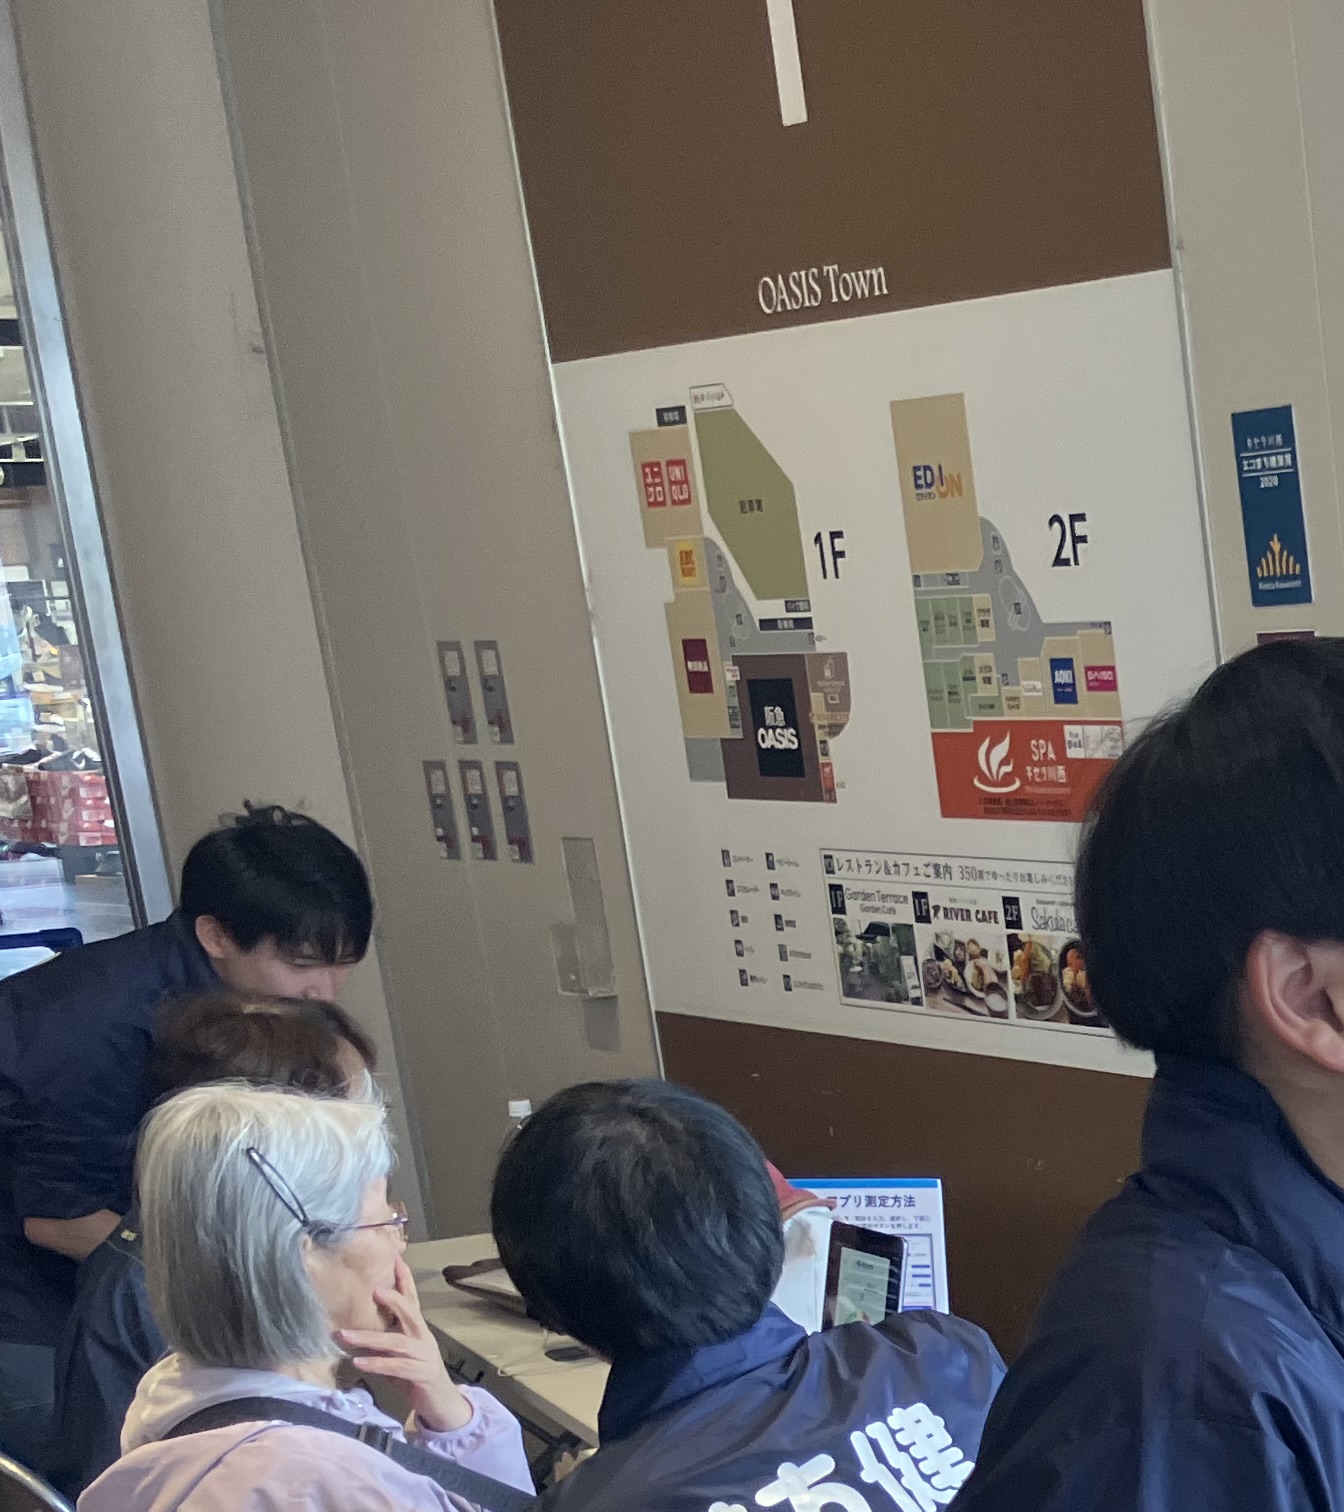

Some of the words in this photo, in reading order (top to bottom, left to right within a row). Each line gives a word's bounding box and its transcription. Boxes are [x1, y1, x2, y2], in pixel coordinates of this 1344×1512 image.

[758, 267, 822, 314] OASIS
[823, 264, 889, 303] Town
[813, 530, 847, 580] 1F
[1048, 512, 1089, 568] 2F
[757, 727, 799, 751] OASIS
[1030, 739, 1057, 761] SPA
[943, 906, 973, 923] RIVER
[974, 908, 1000, 925] CAFE
